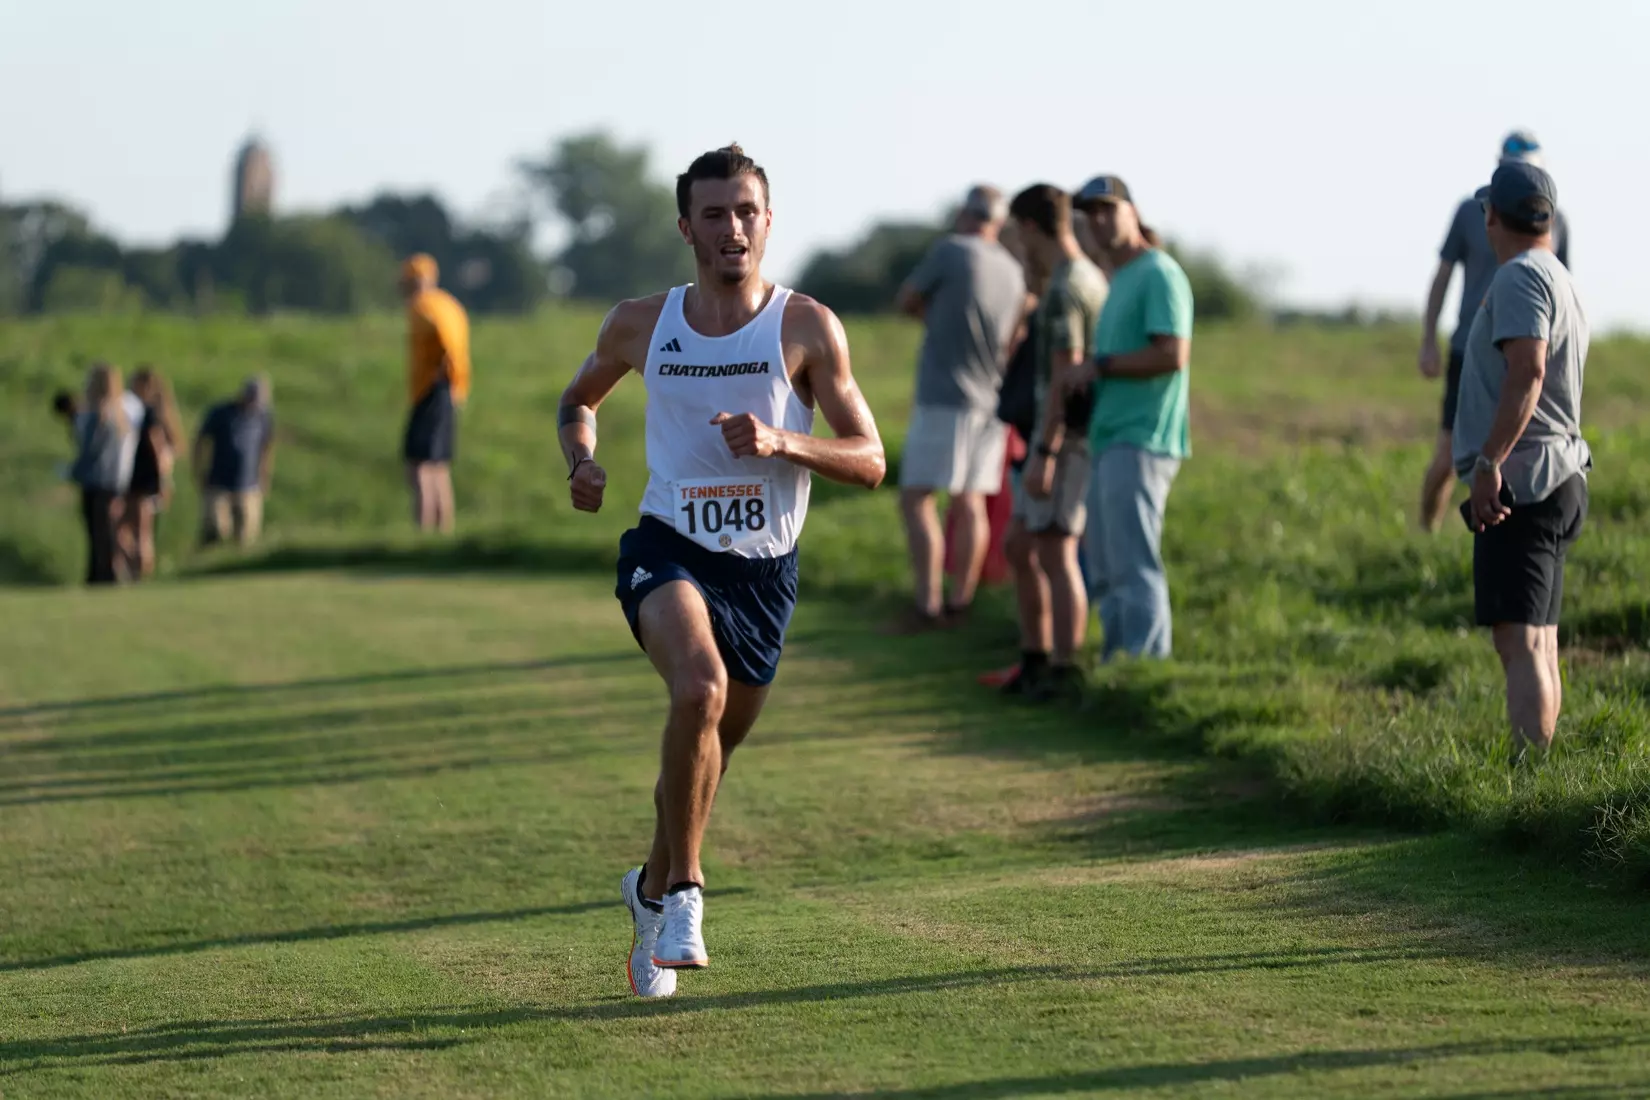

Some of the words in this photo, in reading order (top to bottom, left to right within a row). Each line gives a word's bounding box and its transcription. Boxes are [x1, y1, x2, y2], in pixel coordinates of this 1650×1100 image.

[658, 361, 769, 377] CHATTANOOGA
[681, 484, 764, 499] TENNESSEE
[681, 499, 765, 534] 1048
